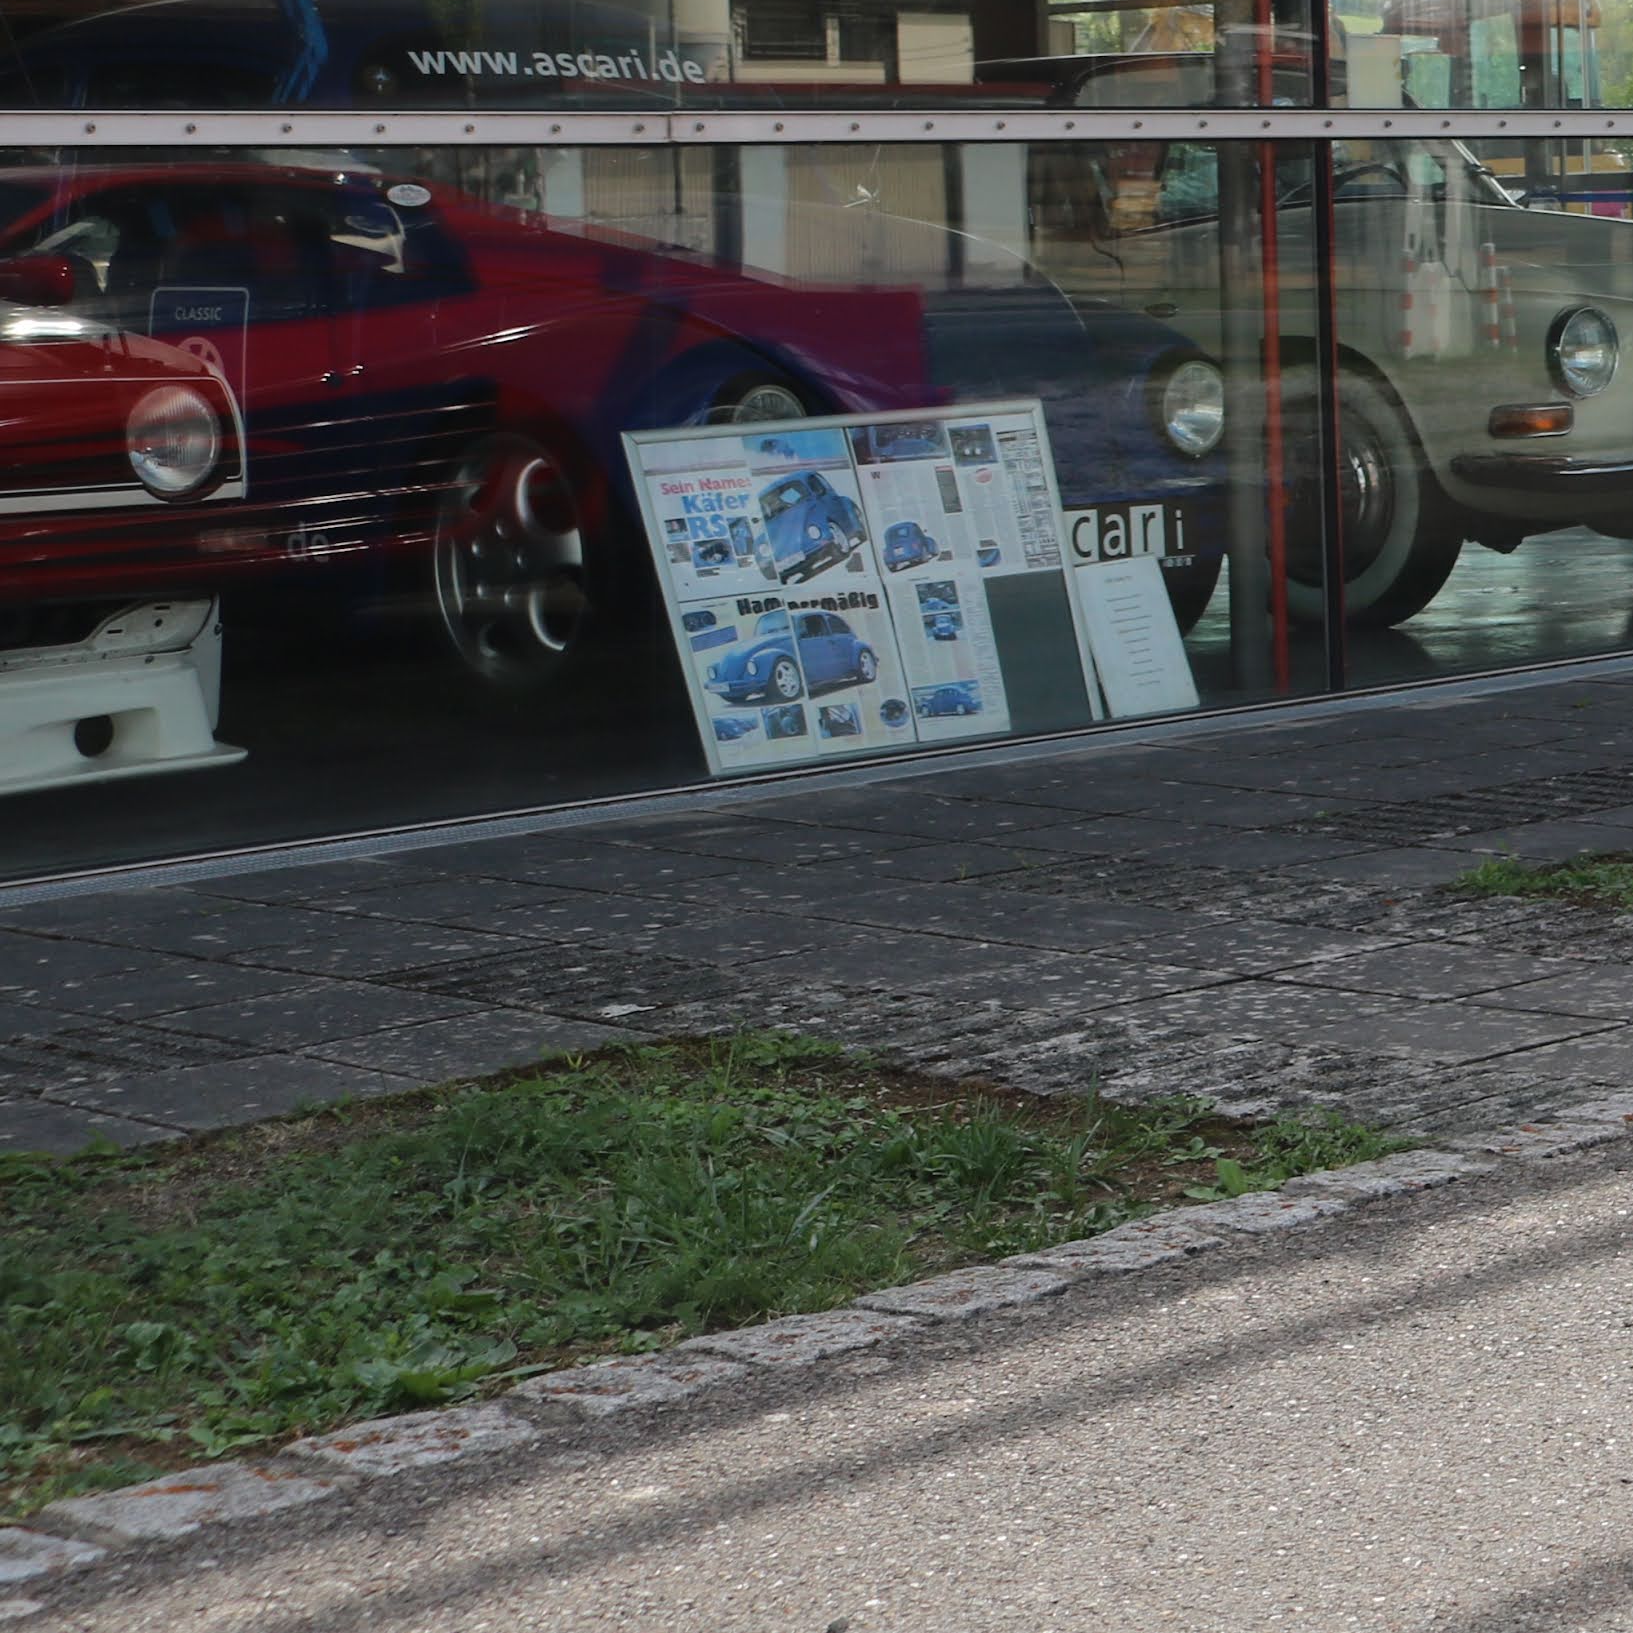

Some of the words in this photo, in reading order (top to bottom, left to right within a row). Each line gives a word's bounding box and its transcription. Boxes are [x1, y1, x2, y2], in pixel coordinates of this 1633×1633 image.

[408, 49, 706, 84] www.ascari.de
[176, 307, 222, 321] CLASSIC
[660, 481, 694, 495] Sein
[682, 493, 750, 514] Käfer
[687, 515, 729, 540] RS
[1071, 509, 1184, 558] cari
